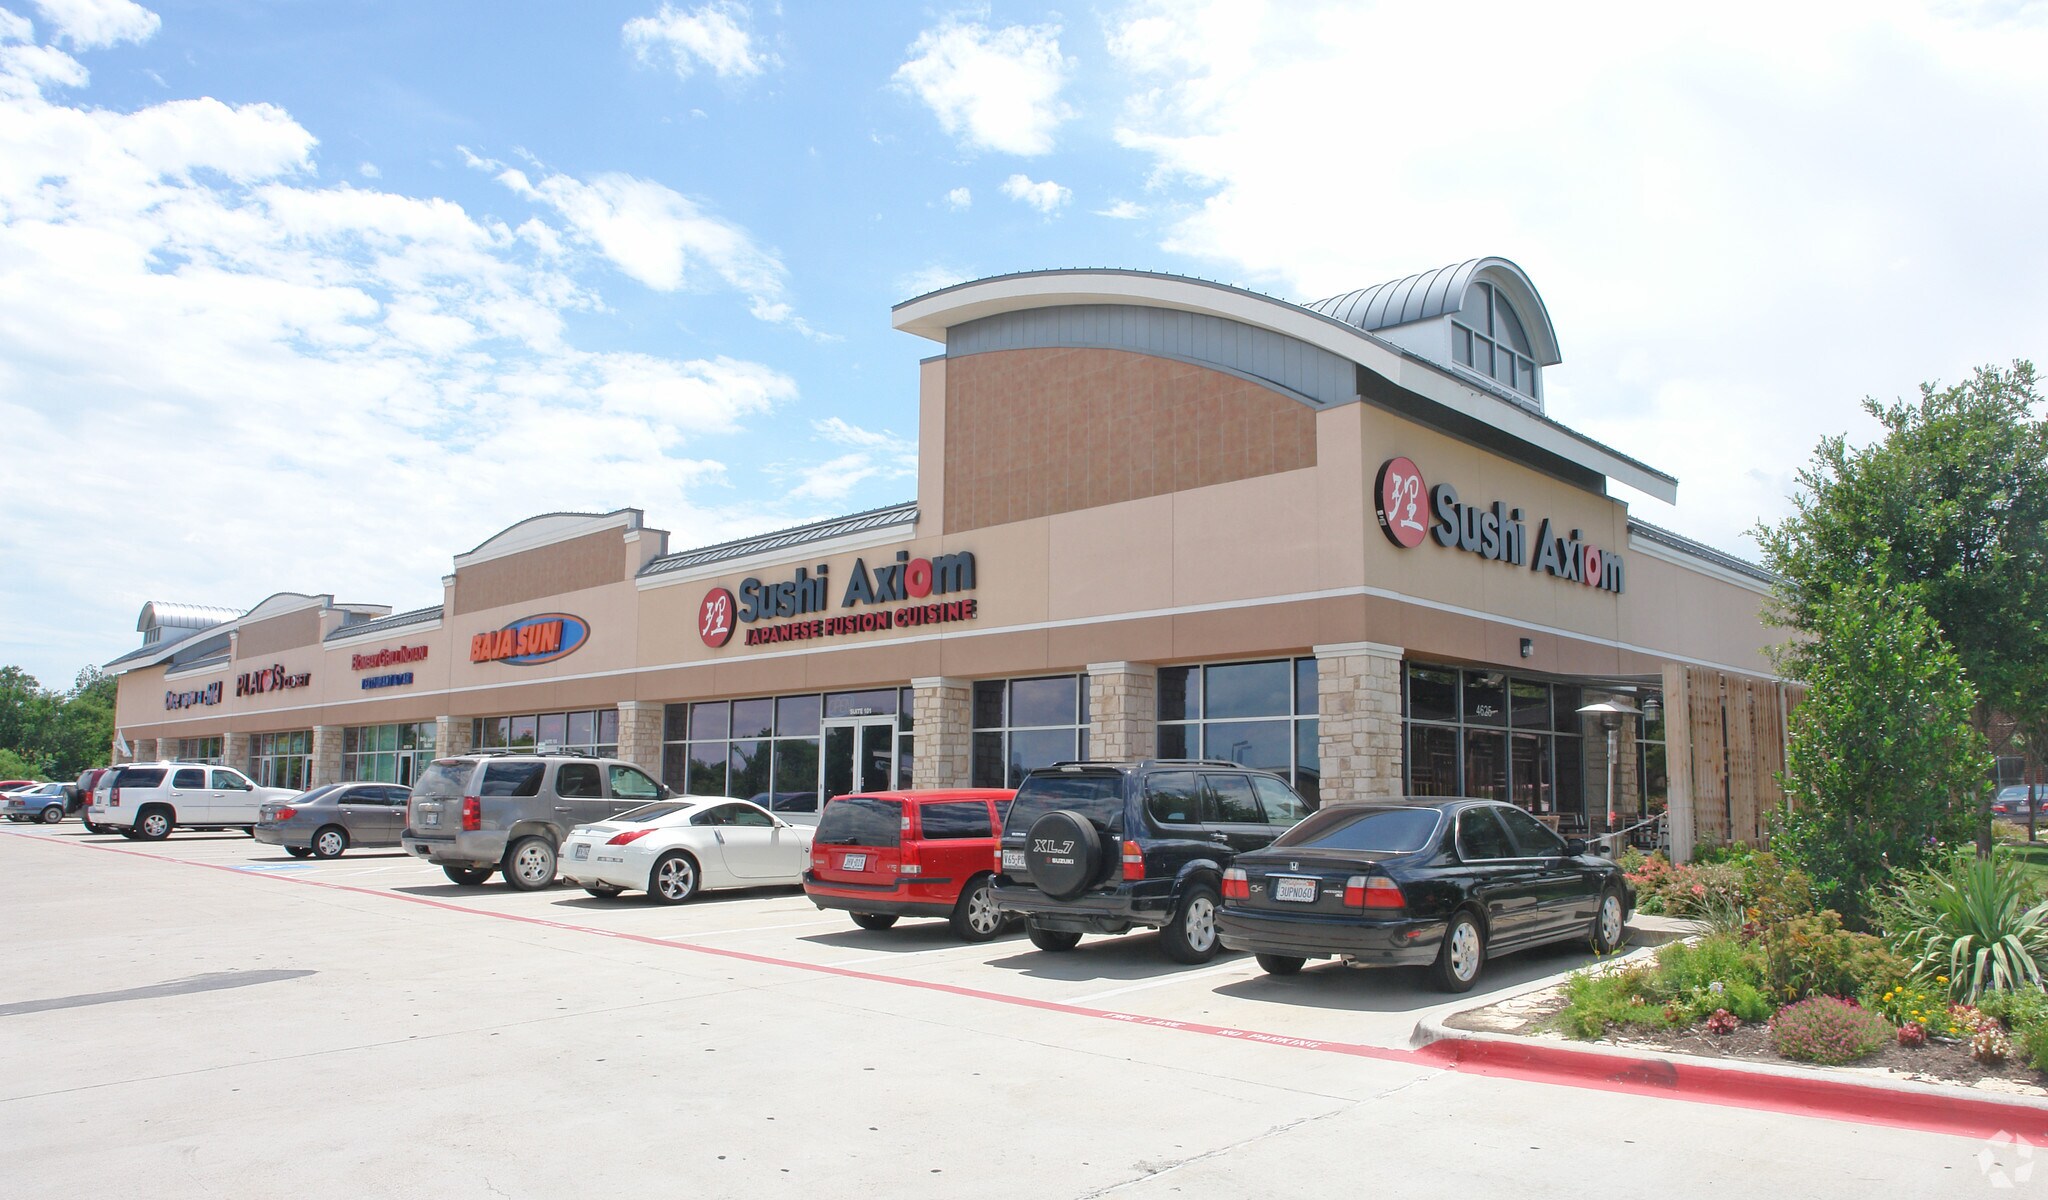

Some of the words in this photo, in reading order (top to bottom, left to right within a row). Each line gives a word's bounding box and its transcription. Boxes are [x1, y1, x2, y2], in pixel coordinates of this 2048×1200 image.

[1430, 483, 1526, 566] Sushi
[1531, 518, 1625, 593] Axiom
[738, 564, 828, 623] Sushi
[841, 550, 977, 608] Axiom
[470, 628, 518, 663] BAJA
[517, 620, 564, 656] SUN
[744, 620, 824, 646] JAPANESE
[824, 611, 892, 635] FUSION
[894, 599, 977, 628] CUISINE
[379, 649, 401, 667] GRILL
[1280, 886, 1312, 898] 3UPN060
[1102, 1013, 1140, 1021] FIRE
[1141, 1018, 1187, 1028] LANE
[1216, 1029, 1244, 1037] NO
[1247, 1033, 1333, 1048] PARKING
